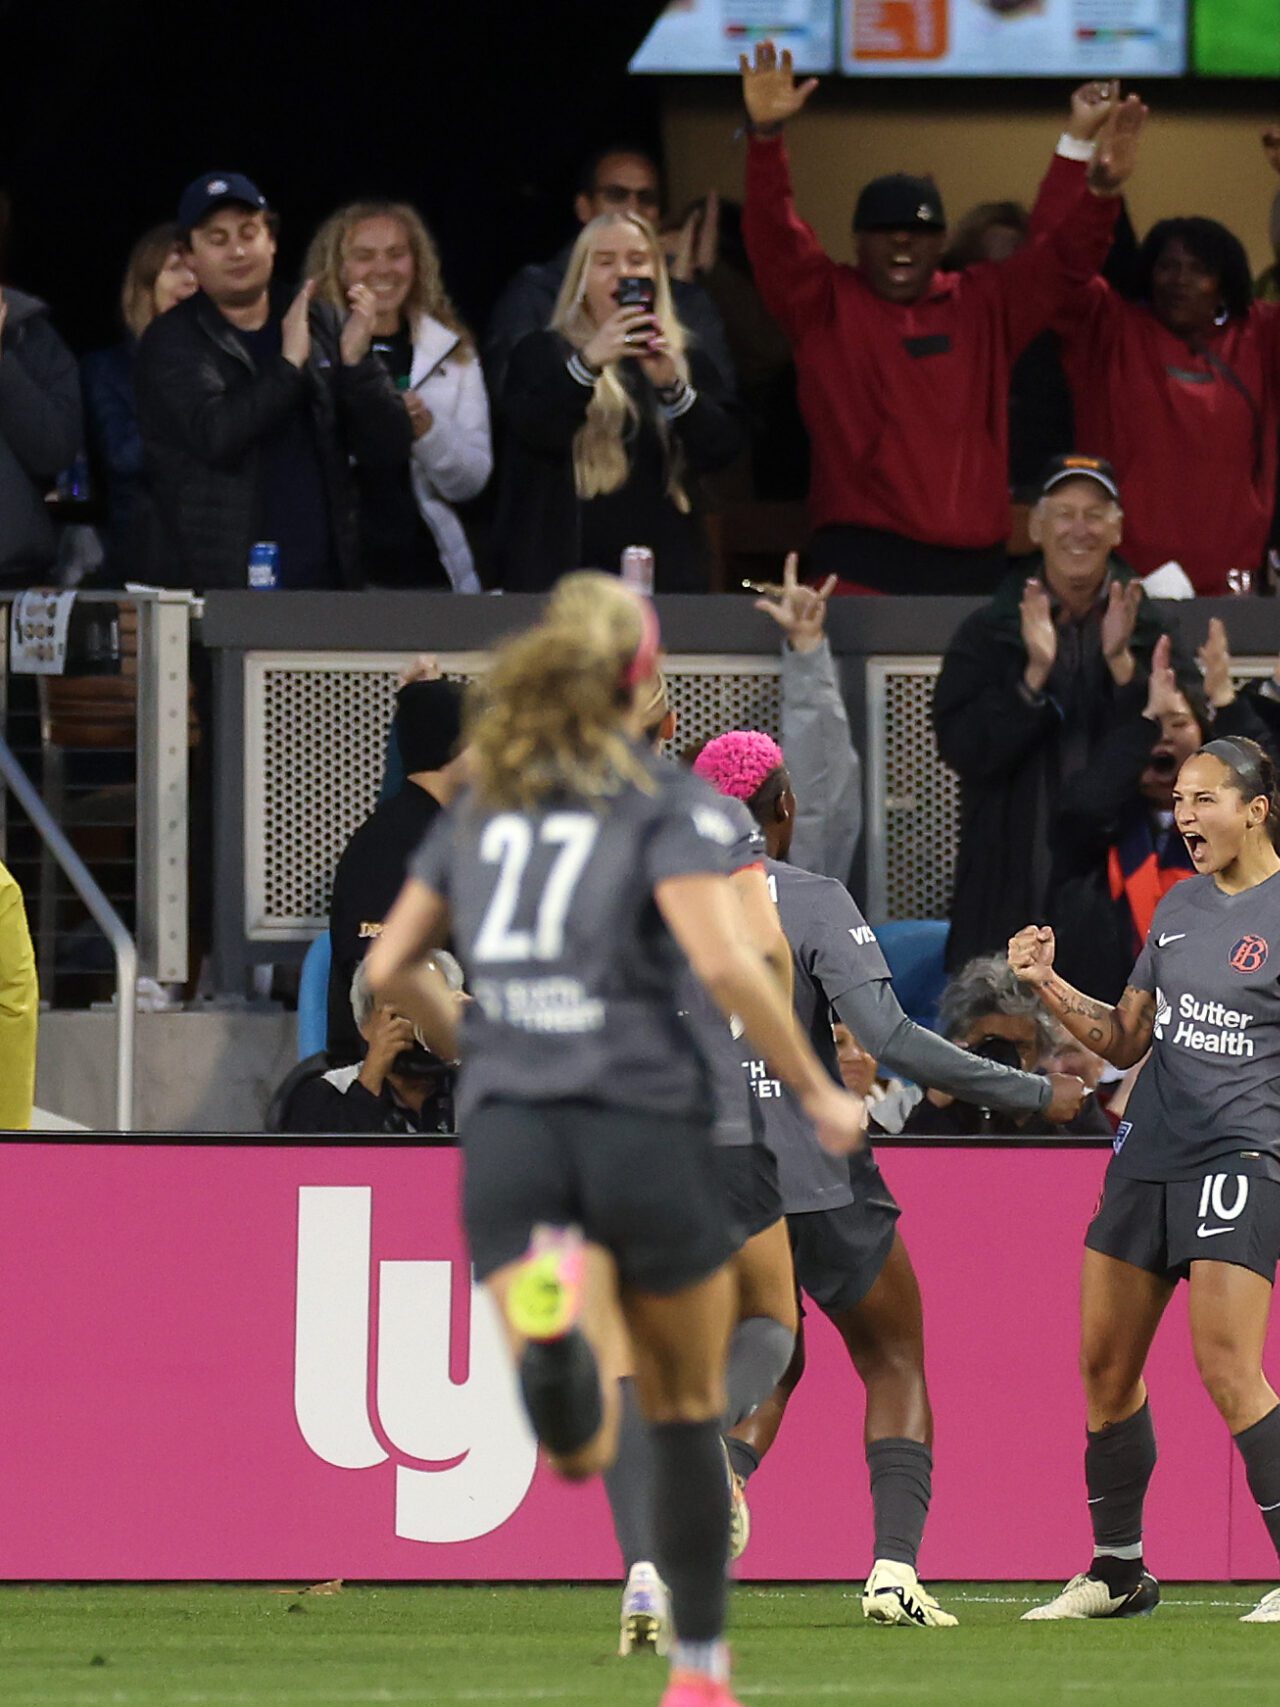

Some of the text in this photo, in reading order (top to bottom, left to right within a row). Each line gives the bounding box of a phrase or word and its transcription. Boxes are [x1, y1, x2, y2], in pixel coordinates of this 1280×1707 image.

[474, 812, 599, 962] 27
[1178, 993, 1254, 1031] Sutter
[1173, 1022, 1254, 1057] Health
[1198, 1174, 1248, 1219] 10
